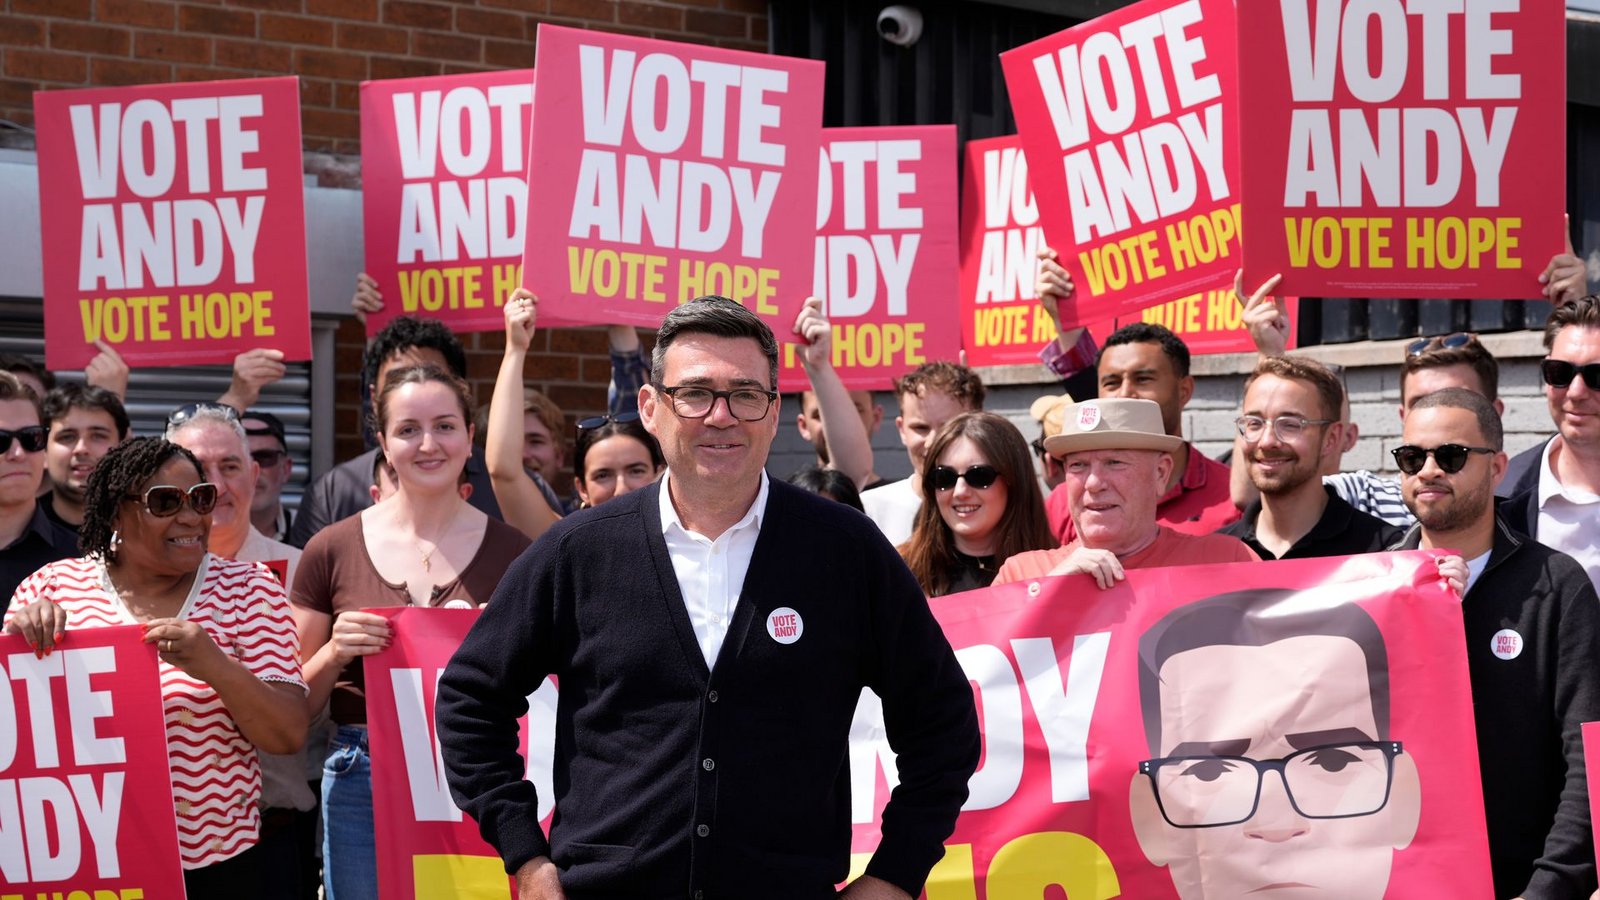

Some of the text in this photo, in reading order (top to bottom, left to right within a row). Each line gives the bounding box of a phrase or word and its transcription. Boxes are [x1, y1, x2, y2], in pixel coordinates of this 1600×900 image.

[1033, 5, 1222, 150] VOTE
[1280, 0, 1521, 102] VOTE
[69, 94, 267, 199] VOTE
[392, 83, 534, 179] VOT
[579, 44, 788, 167] VOTE
[816, 139, 924, 230] TE
[984, 147, 1040, 229] VO
[1063, 102, 1231, 245] ANDY
[1284, 107, 1519, 208] ANDY
[78, 196, 266, 291] ANDY
[397, 176, 528, 264] AND
[568, 148, 782, 259] ANDY
[1284, 217, 1522, 270] VOTE HOPE
[398, 266, 484, 312] VOTE
[568, 246, 668, 303] VOTE
[678, 258, 780, 316] HOPE
[812, 233, 921, 317] DY
[975, 226, 1048, 304] AN
[1079, 229, 1167, 298] VOTE
[79, 291, 275, 343] VOTE HOPE
[832, 323, 926, 368] HOPE
[974, 305, 1029, 347] VOTE
[772, 614, 797, 627] VOTE
[774, 626, 797, 637] ANDY
[1496, 645, 1516, 653] ANDY
[1497, 635, 1518, 645] VOTE
